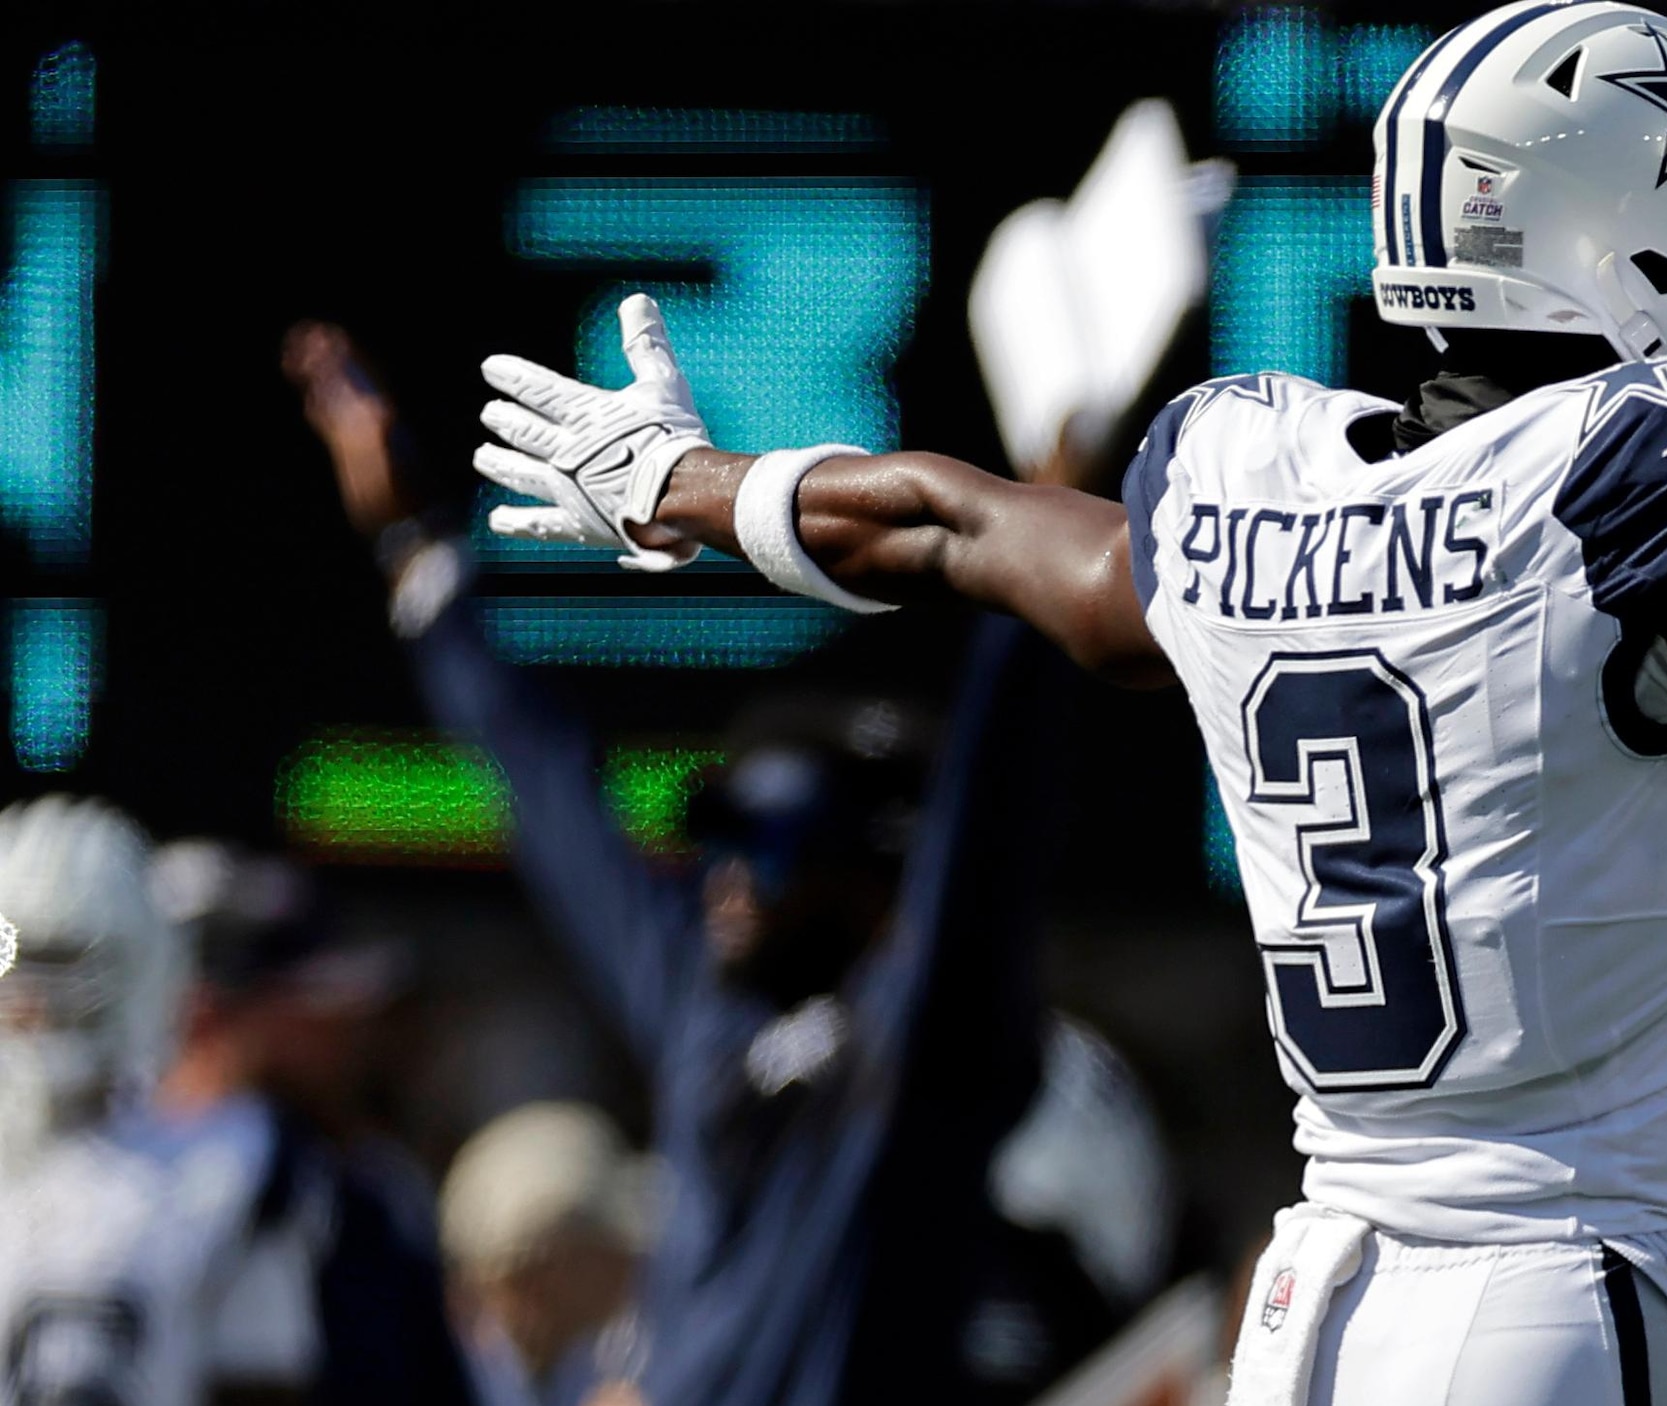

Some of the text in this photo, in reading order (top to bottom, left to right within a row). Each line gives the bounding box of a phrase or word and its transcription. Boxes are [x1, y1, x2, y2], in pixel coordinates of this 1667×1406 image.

[1463, 202, 1503, 217] CATCH
[1380, 283, 1476, 312] COWBOYS
[1182, 489, 1493, 621] PICKENS
[1242, 648, 1467, 1093] 3
